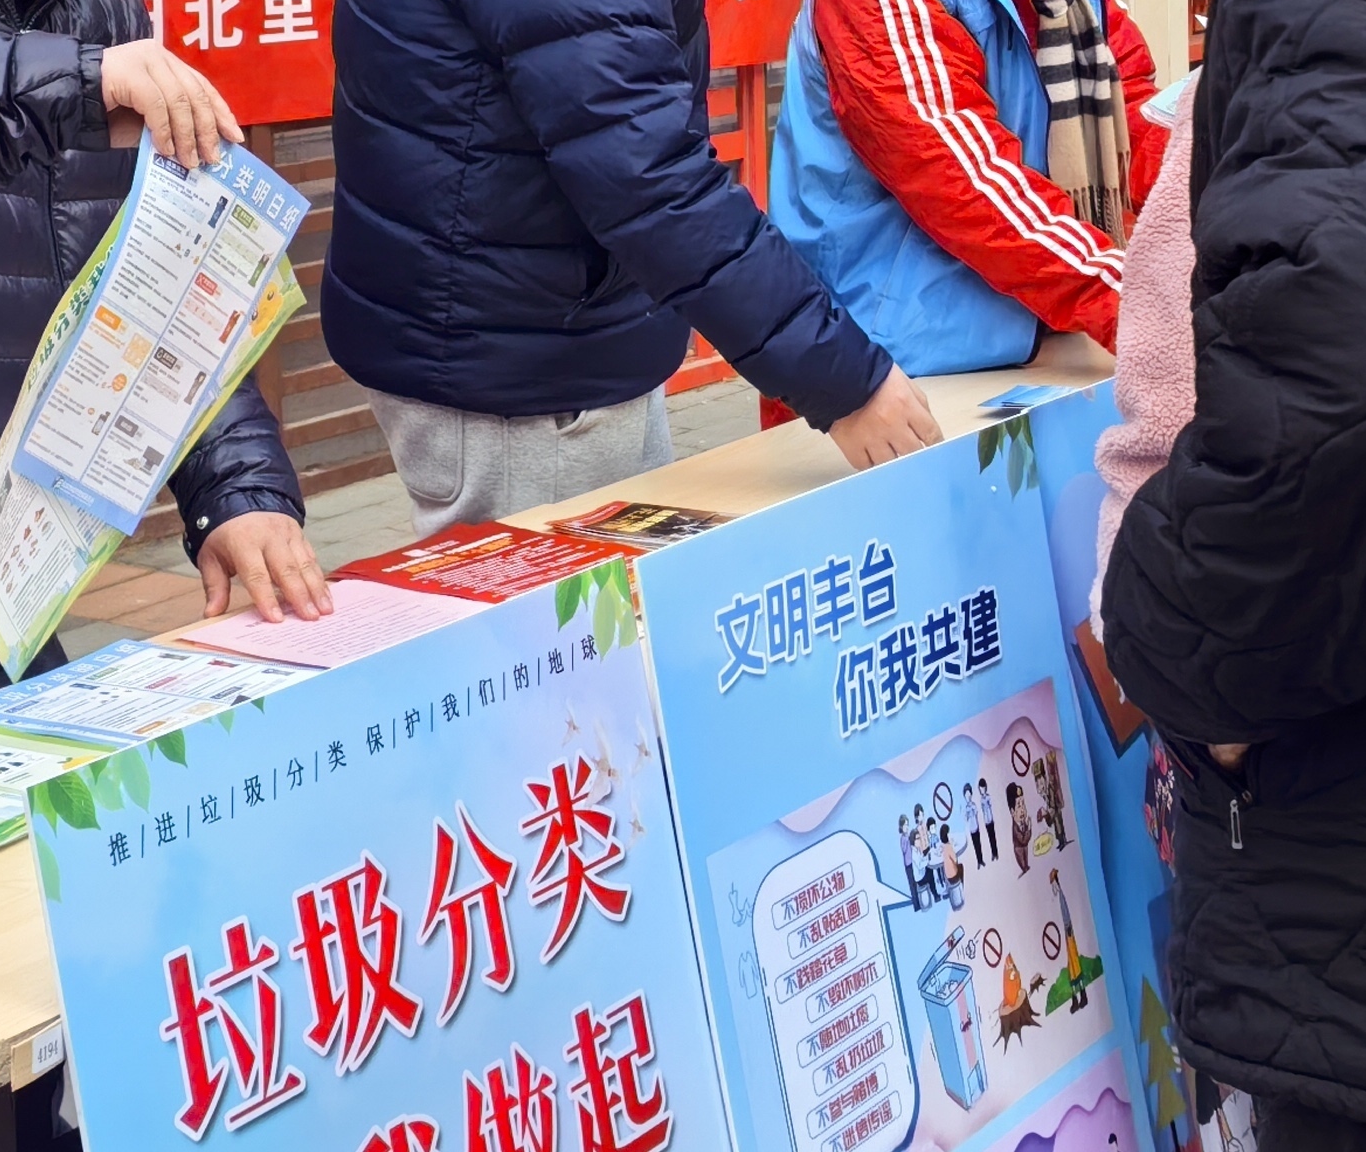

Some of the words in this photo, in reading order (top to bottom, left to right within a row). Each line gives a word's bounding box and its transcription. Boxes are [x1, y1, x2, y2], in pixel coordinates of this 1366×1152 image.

[714, 541, 898, 690] 文明丰台
[833, 585, 1002, 737] 你我共建
[780, 870, 846, 921] 不损坏公物
[797, 896, 861, 949] 不乱贴乱画
[160, 754, 633, 1140] 垃圾分类
[783, 942, 848, 996] 不践踏花草
[815, 961, 879, 1014] 不毁坏树木
[37, 1039, 59, 1064] 4194
[806, 1002, 870, 1058] 不随地吐痰
[822, 1029, 886, 1086] 不乱扔垃圾
[353, 989, 674, 1152] 做起
[815, 1070, 879, 1129] 不参与赌博
[828, 1098, 893, 1152] 不迷信传谣
